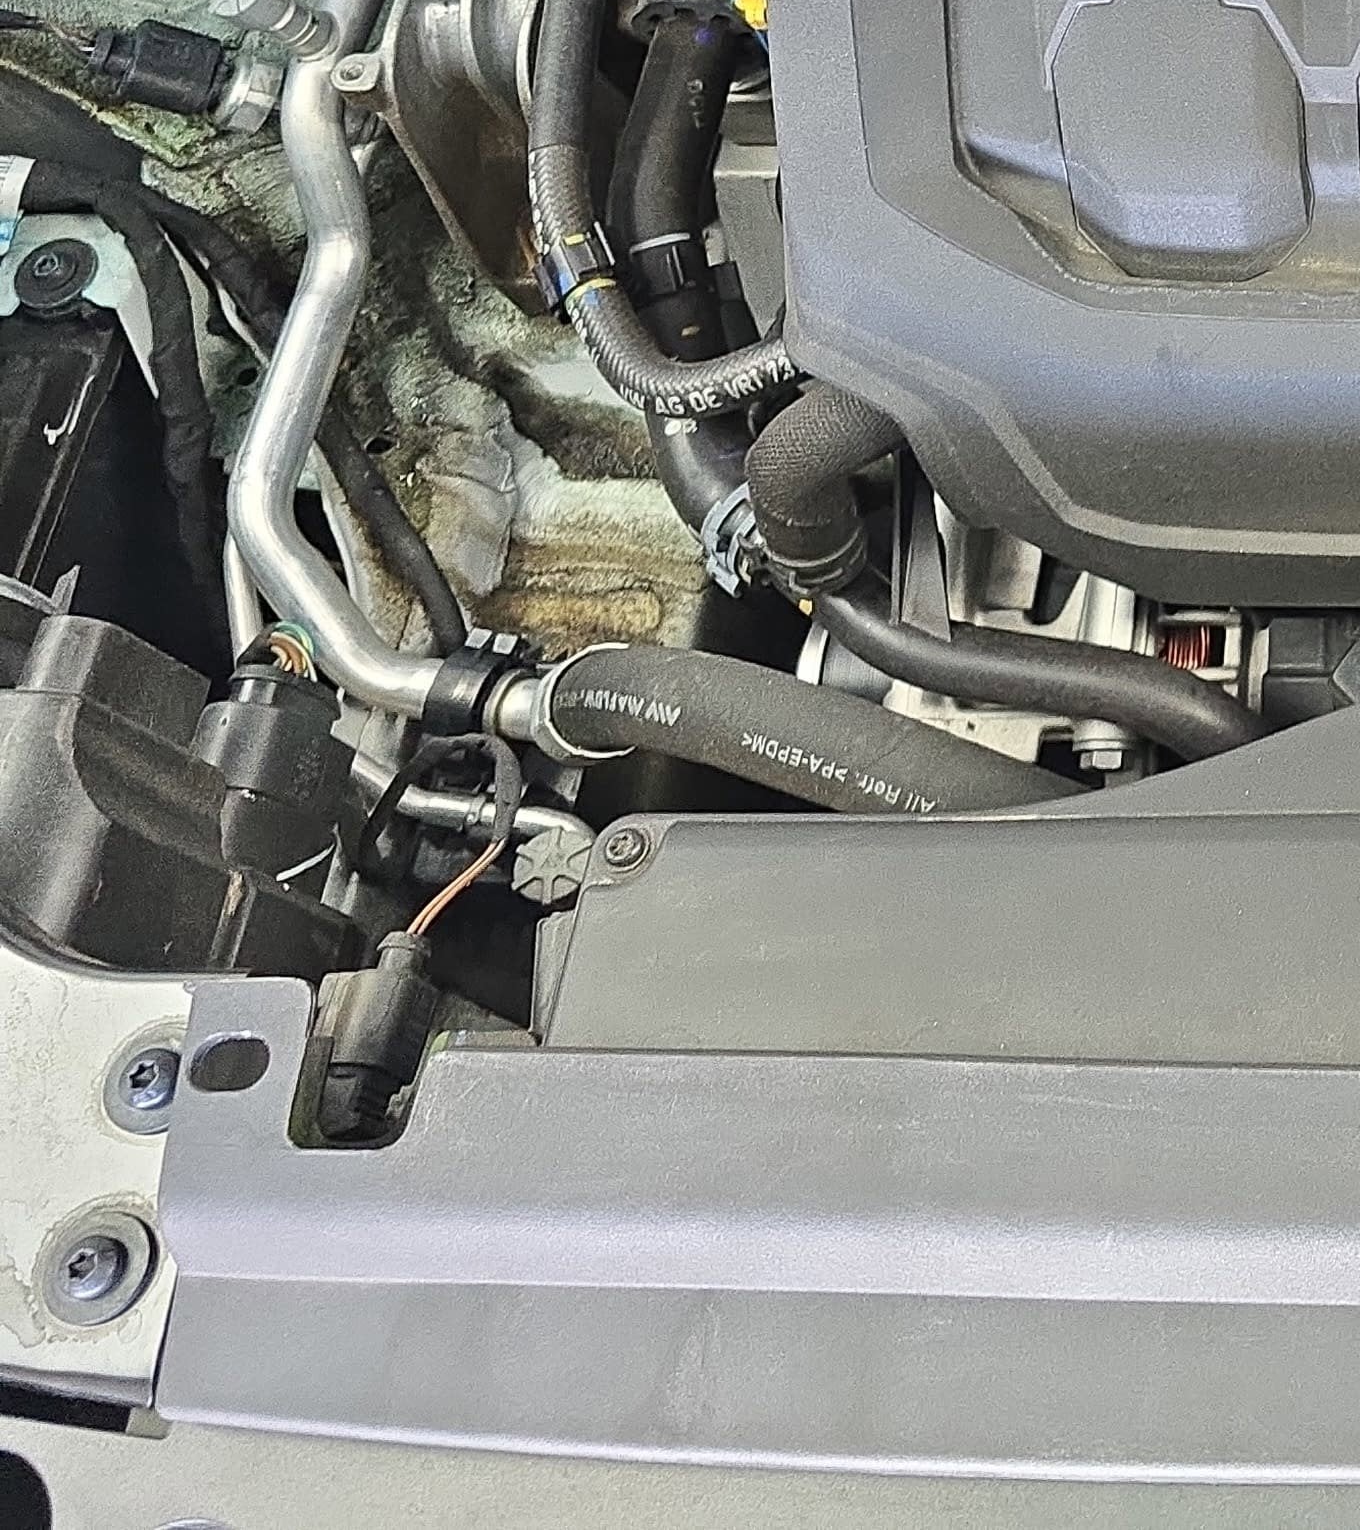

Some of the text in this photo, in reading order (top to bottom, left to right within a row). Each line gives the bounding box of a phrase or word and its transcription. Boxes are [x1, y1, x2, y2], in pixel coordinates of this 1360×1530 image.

[619, 384, 646, 411] VW
[655, 396, 685, 416] AG
[689, 389, 723, 413] DE
[741, 732, 848, 780] >PA-EPDM<
[908, 792, 936, 813] All
